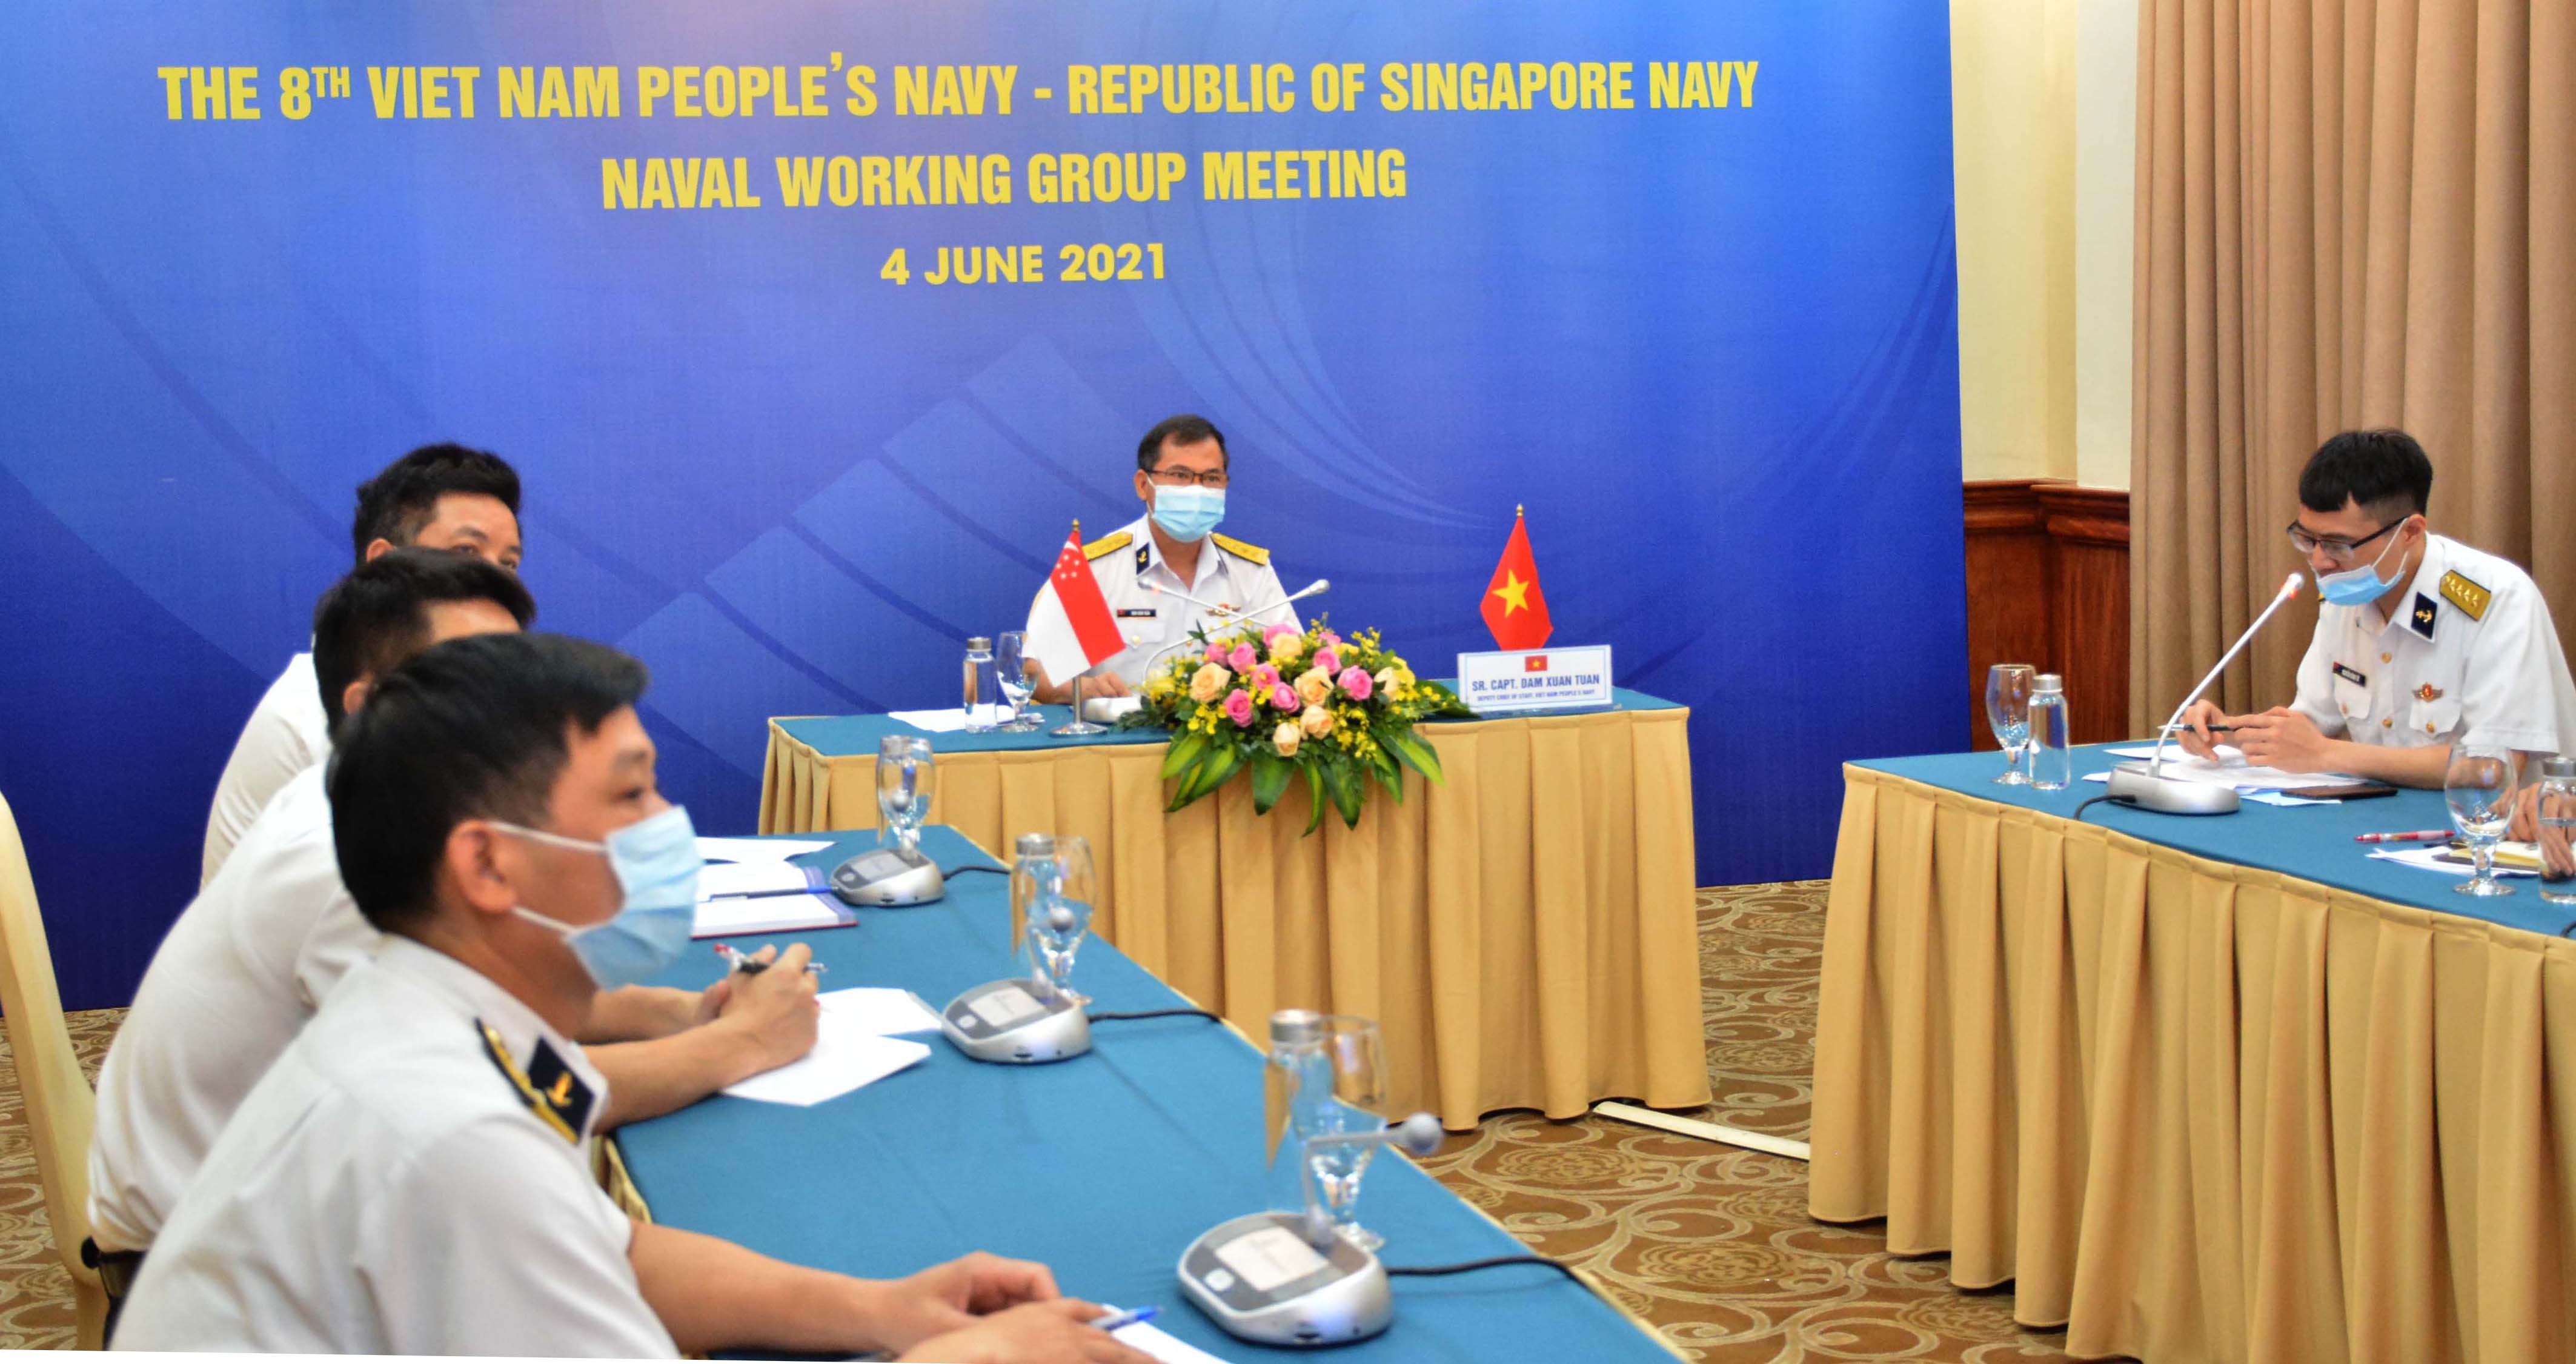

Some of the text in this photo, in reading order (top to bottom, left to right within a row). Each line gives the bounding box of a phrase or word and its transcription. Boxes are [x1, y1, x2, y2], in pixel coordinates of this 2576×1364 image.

[158, 51, 1758, 120] THE 8TH VIET NAM PEOPLE'S NAVY - REPUBLIC OF SINGAPORE NAVY
[602, 148, 1406, 209] NAVAL WORKING GROUP MEETING
[881, 242, 1164, 285] 4 JUNE 2021
[1472, 680, 1488, 691] SR.
[1491, 679, 1518, 691] CAPT.
[1547, 676, 1572, 687] XUAN
[1575, 674, 1599, 685] TUAN
